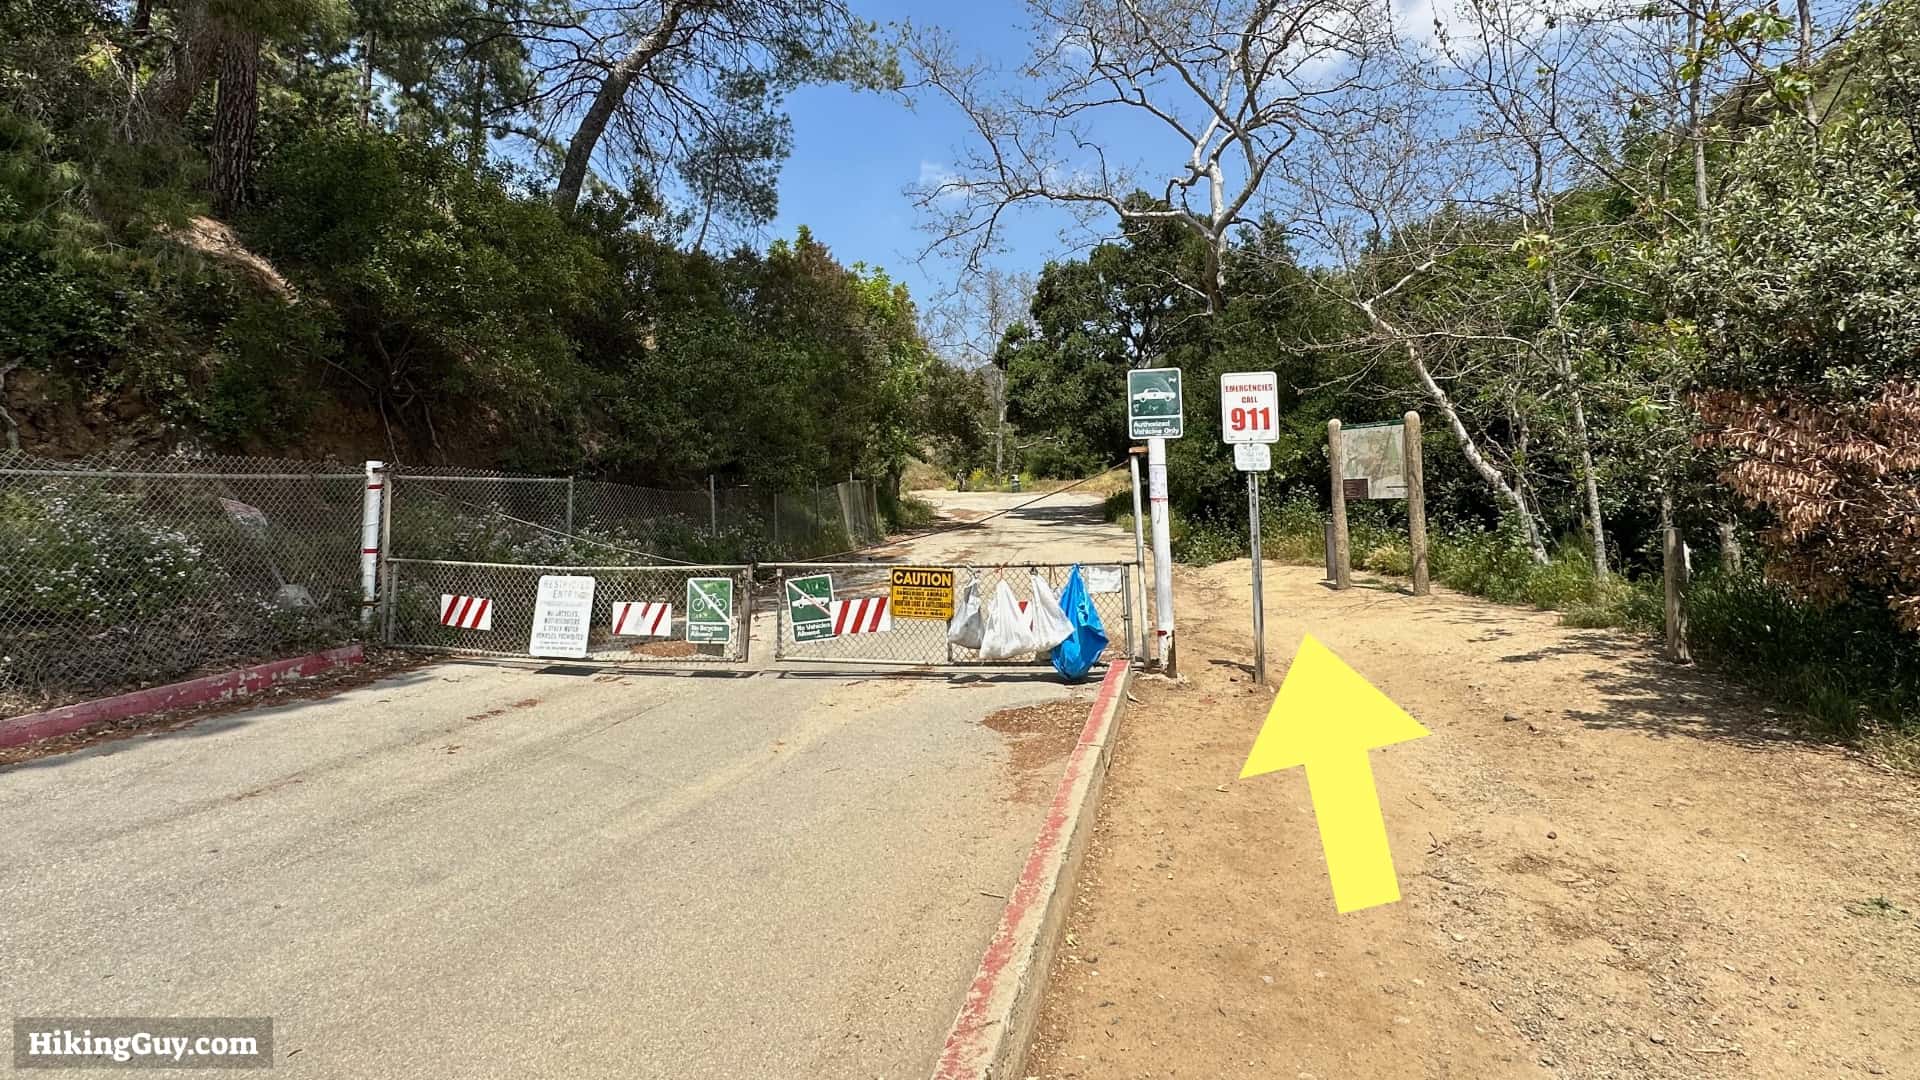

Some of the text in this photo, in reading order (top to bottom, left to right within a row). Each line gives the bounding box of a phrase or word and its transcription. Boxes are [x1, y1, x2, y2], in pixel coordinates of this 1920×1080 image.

[1225, 384, 1273, 393] EMERGENCIES
[1241, 395, 1258, 403] CALL
[1231, 407, 1270, 431] 911
[1134, 420, 1170, 428] Authorized
[1164, 426, 1180, 435] Only
[893, 571, 952, 587] CAUTION
[806, 622, 831, 631] Vehicles
